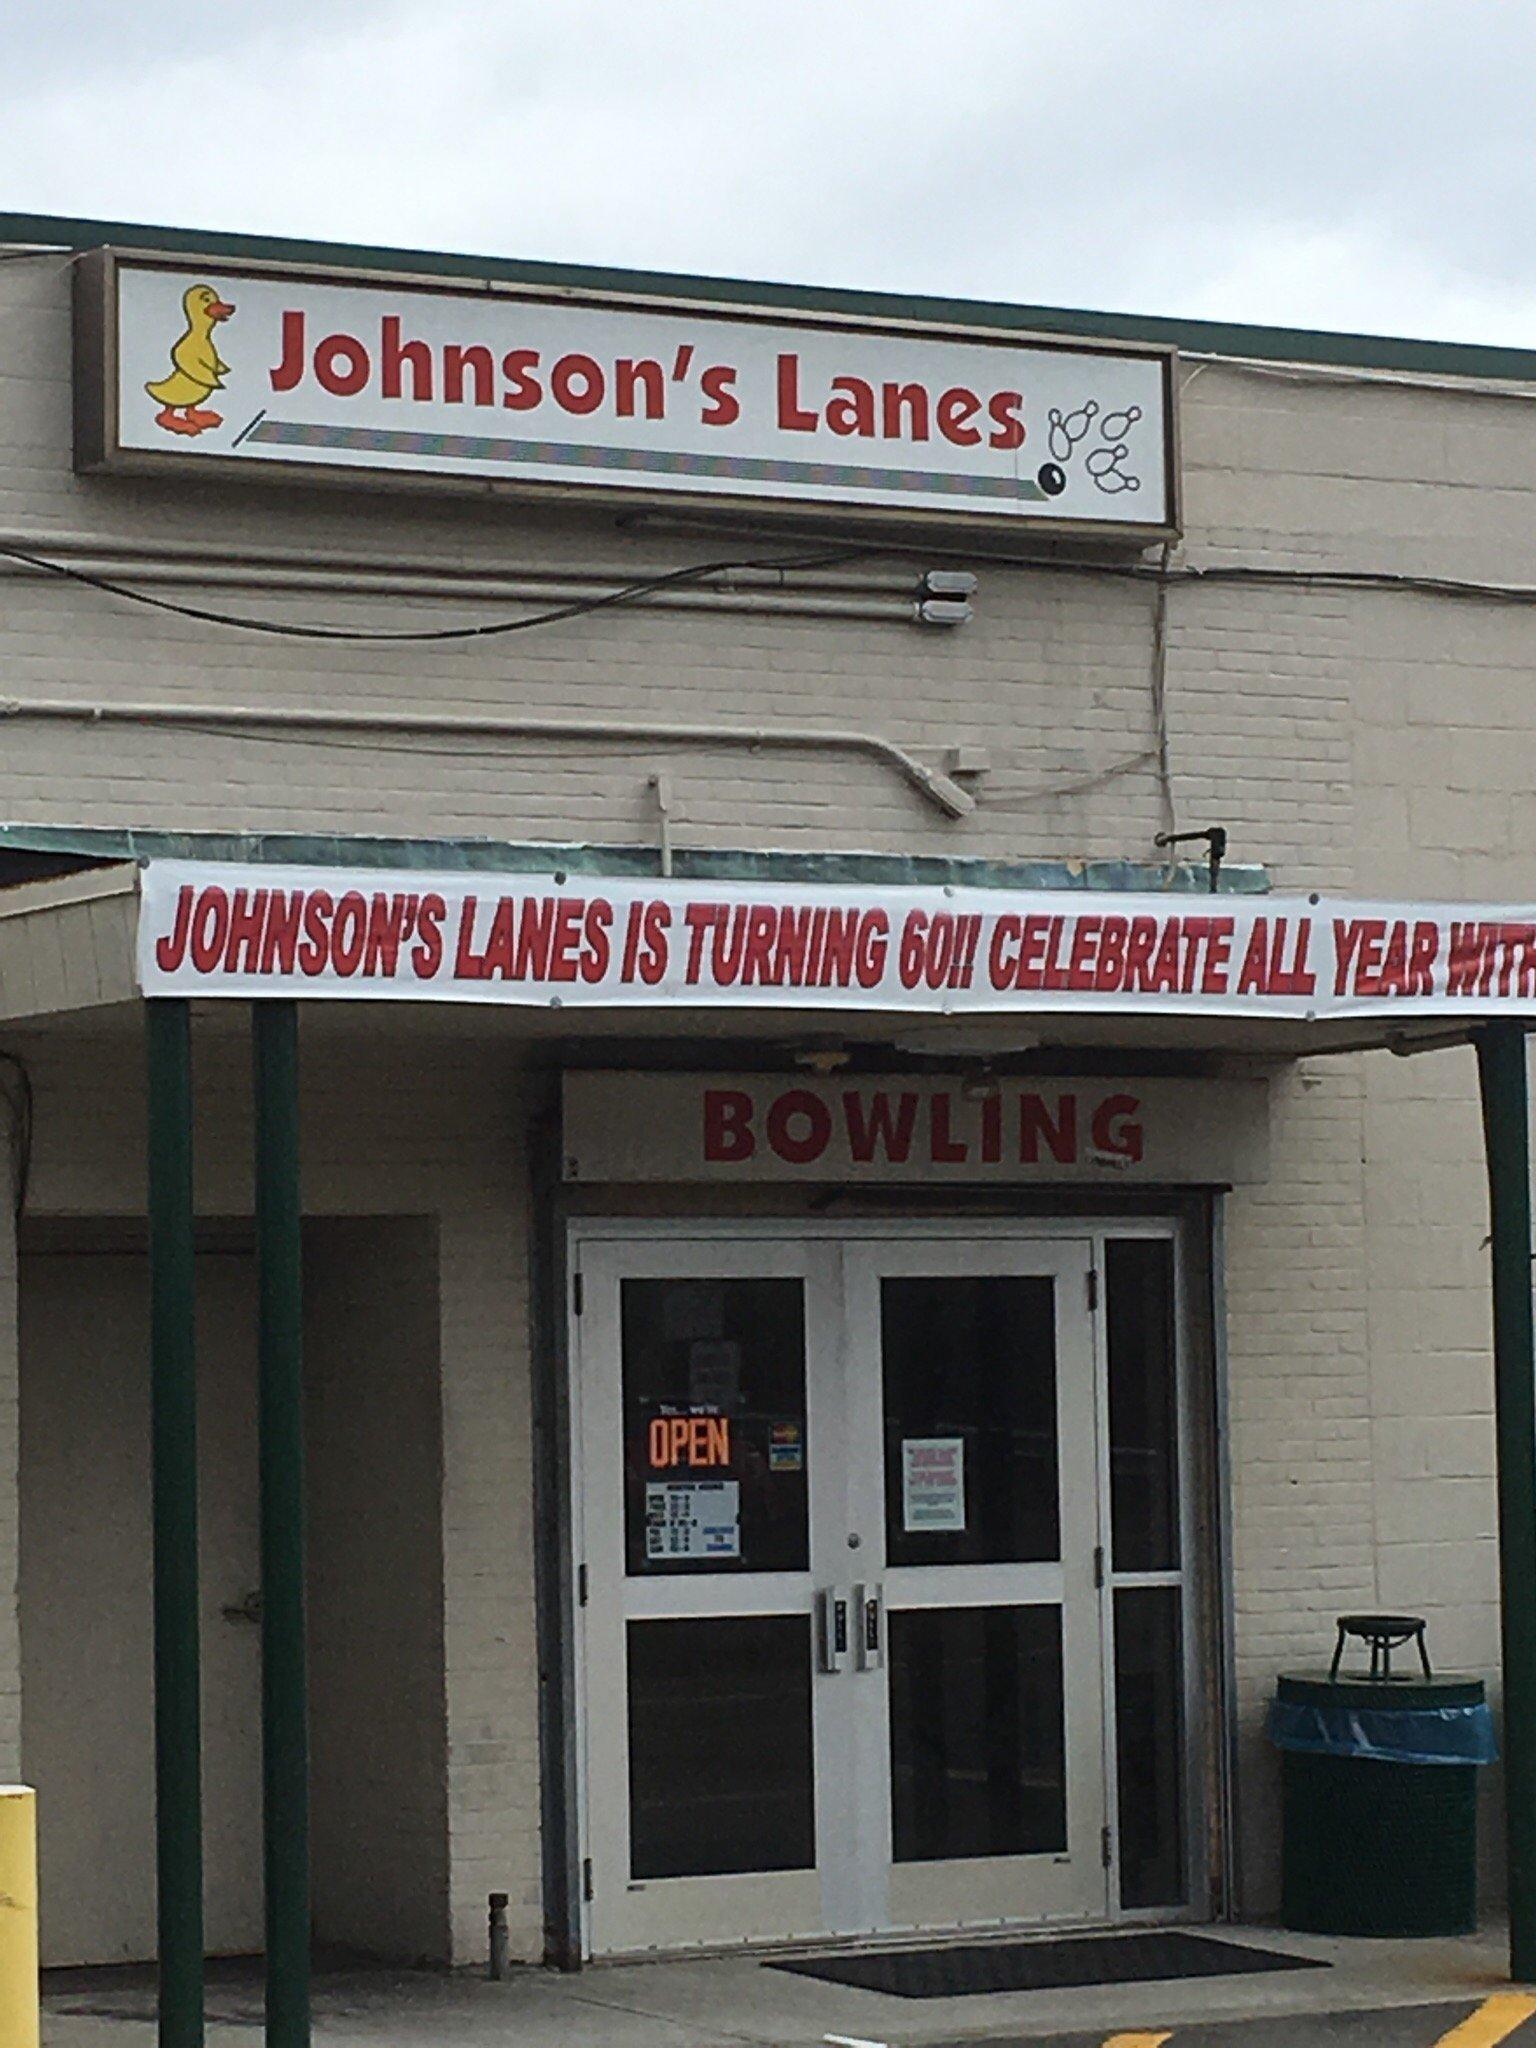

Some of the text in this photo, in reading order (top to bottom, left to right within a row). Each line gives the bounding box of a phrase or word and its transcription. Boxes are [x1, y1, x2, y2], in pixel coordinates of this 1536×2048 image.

[270, 310, 1026, 450] Johnson's Lanes
[156, 884, 1536, 997] JOHNSON'S LANES IS TURNING 60!! CELEBRATE ALL YEAR WITH
[704, 1088, 1144, 1166] BOWLING
[650, 1418, 730, 1468] OPEN
